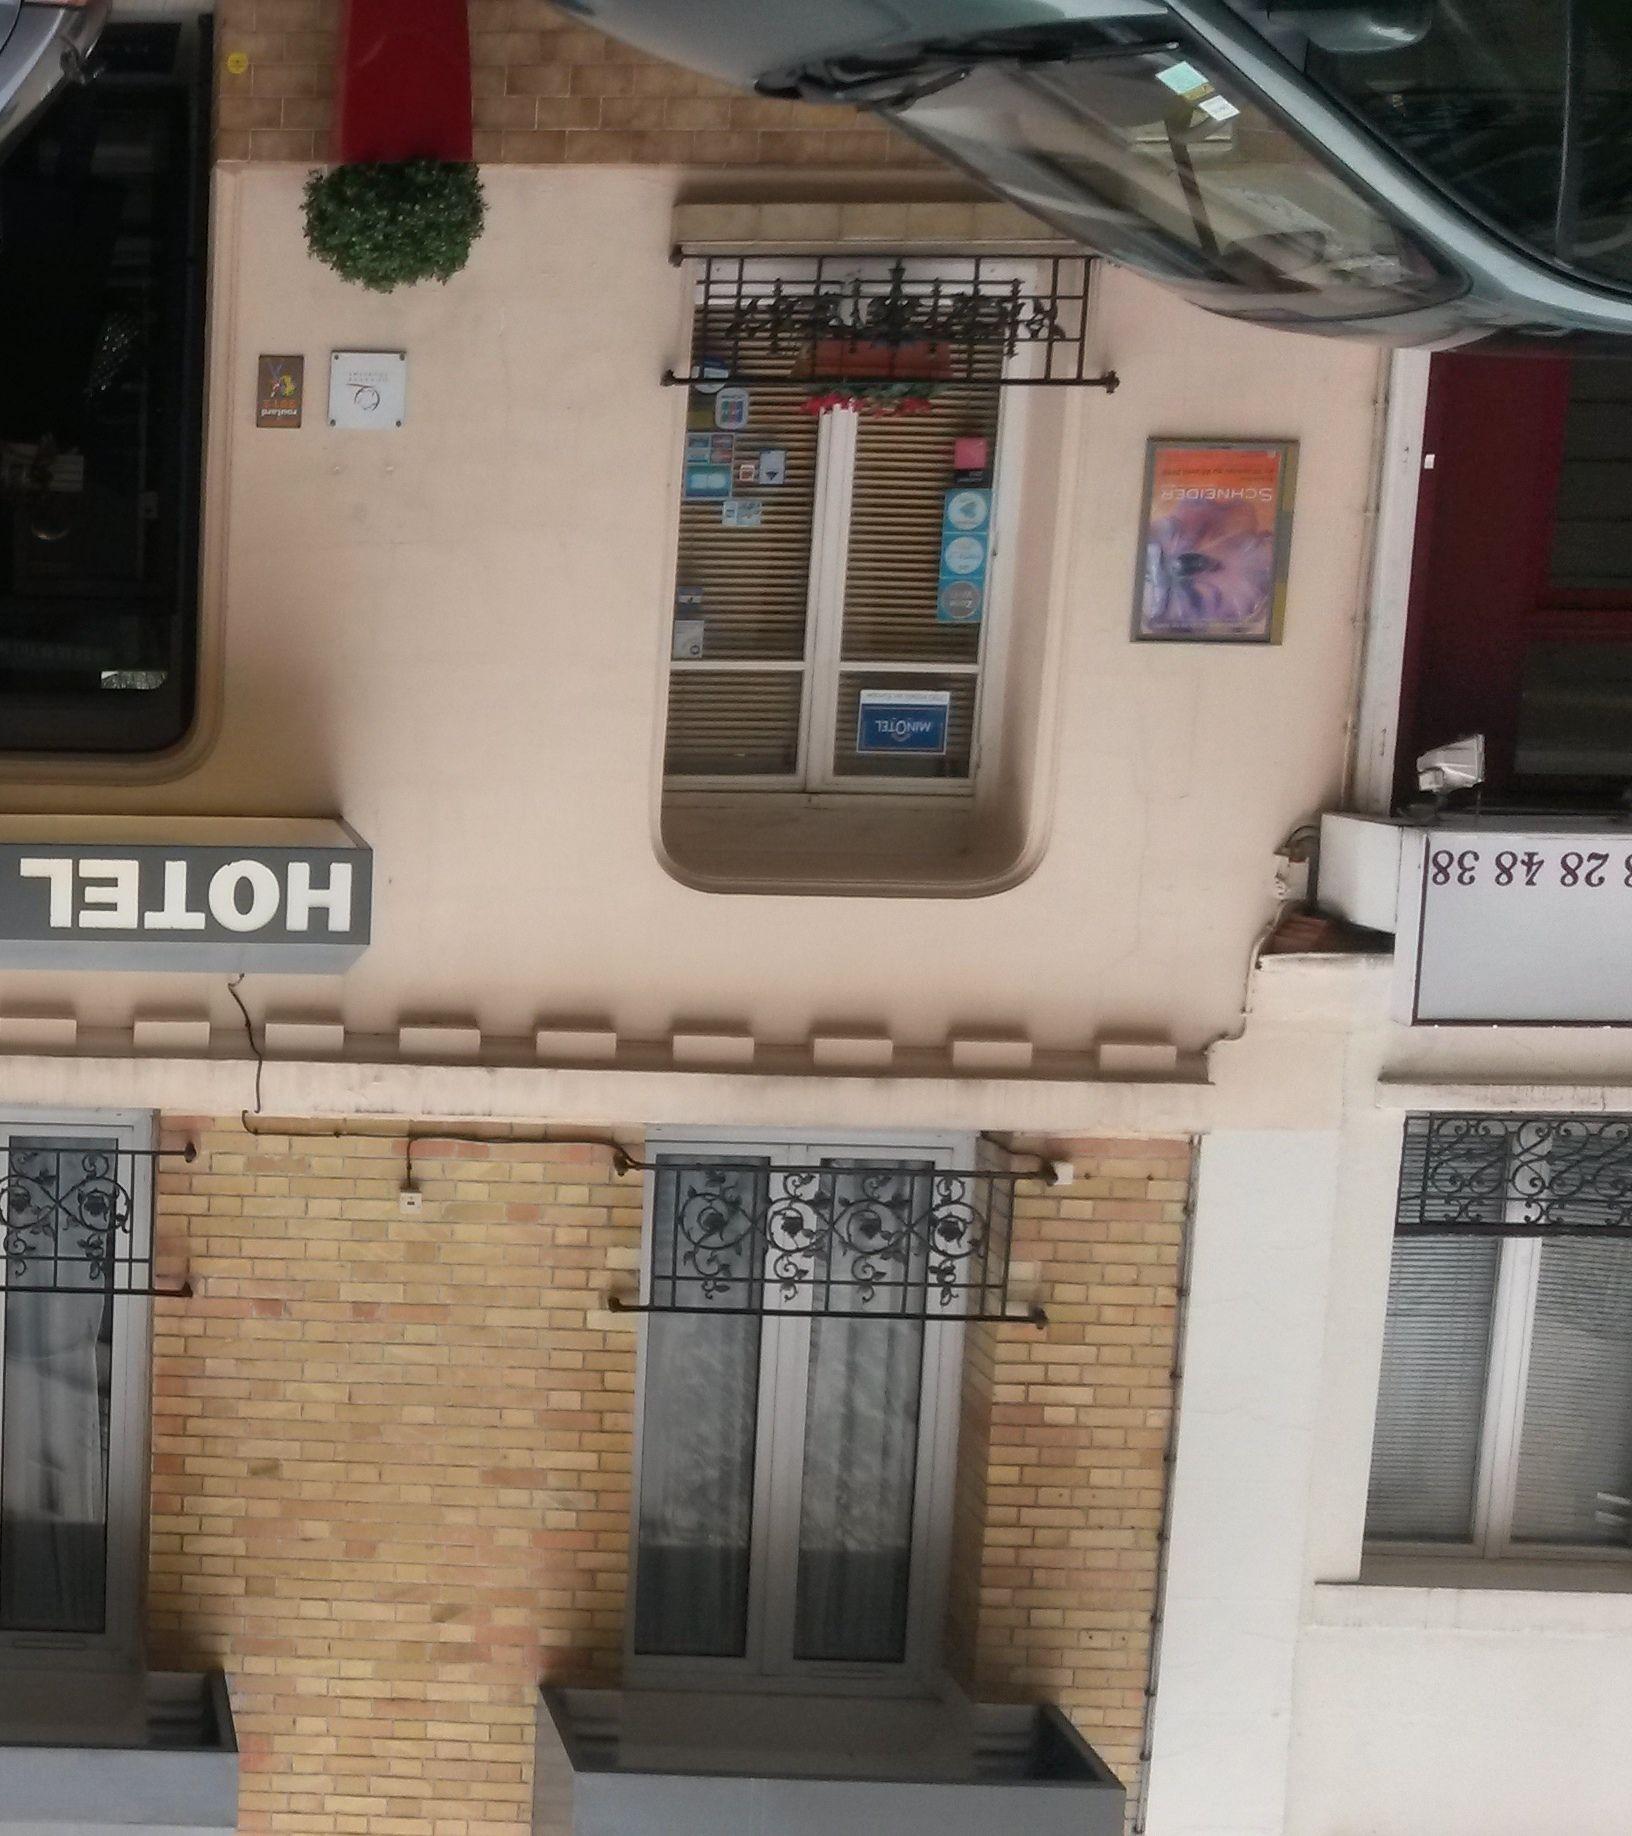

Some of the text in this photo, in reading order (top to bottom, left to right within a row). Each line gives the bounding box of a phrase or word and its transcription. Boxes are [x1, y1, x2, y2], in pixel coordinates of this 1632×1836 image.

[1161, 486, 1274, 502] SCHNEIDER
[875, 719, 932, 736] MINOTEL
[1431, 849, 1480, 886] 38
[1494, 850, 1544, 887] 48
[1559, 851, 1609, 888] 28
[20, 857, 352, 932] HOTEL
